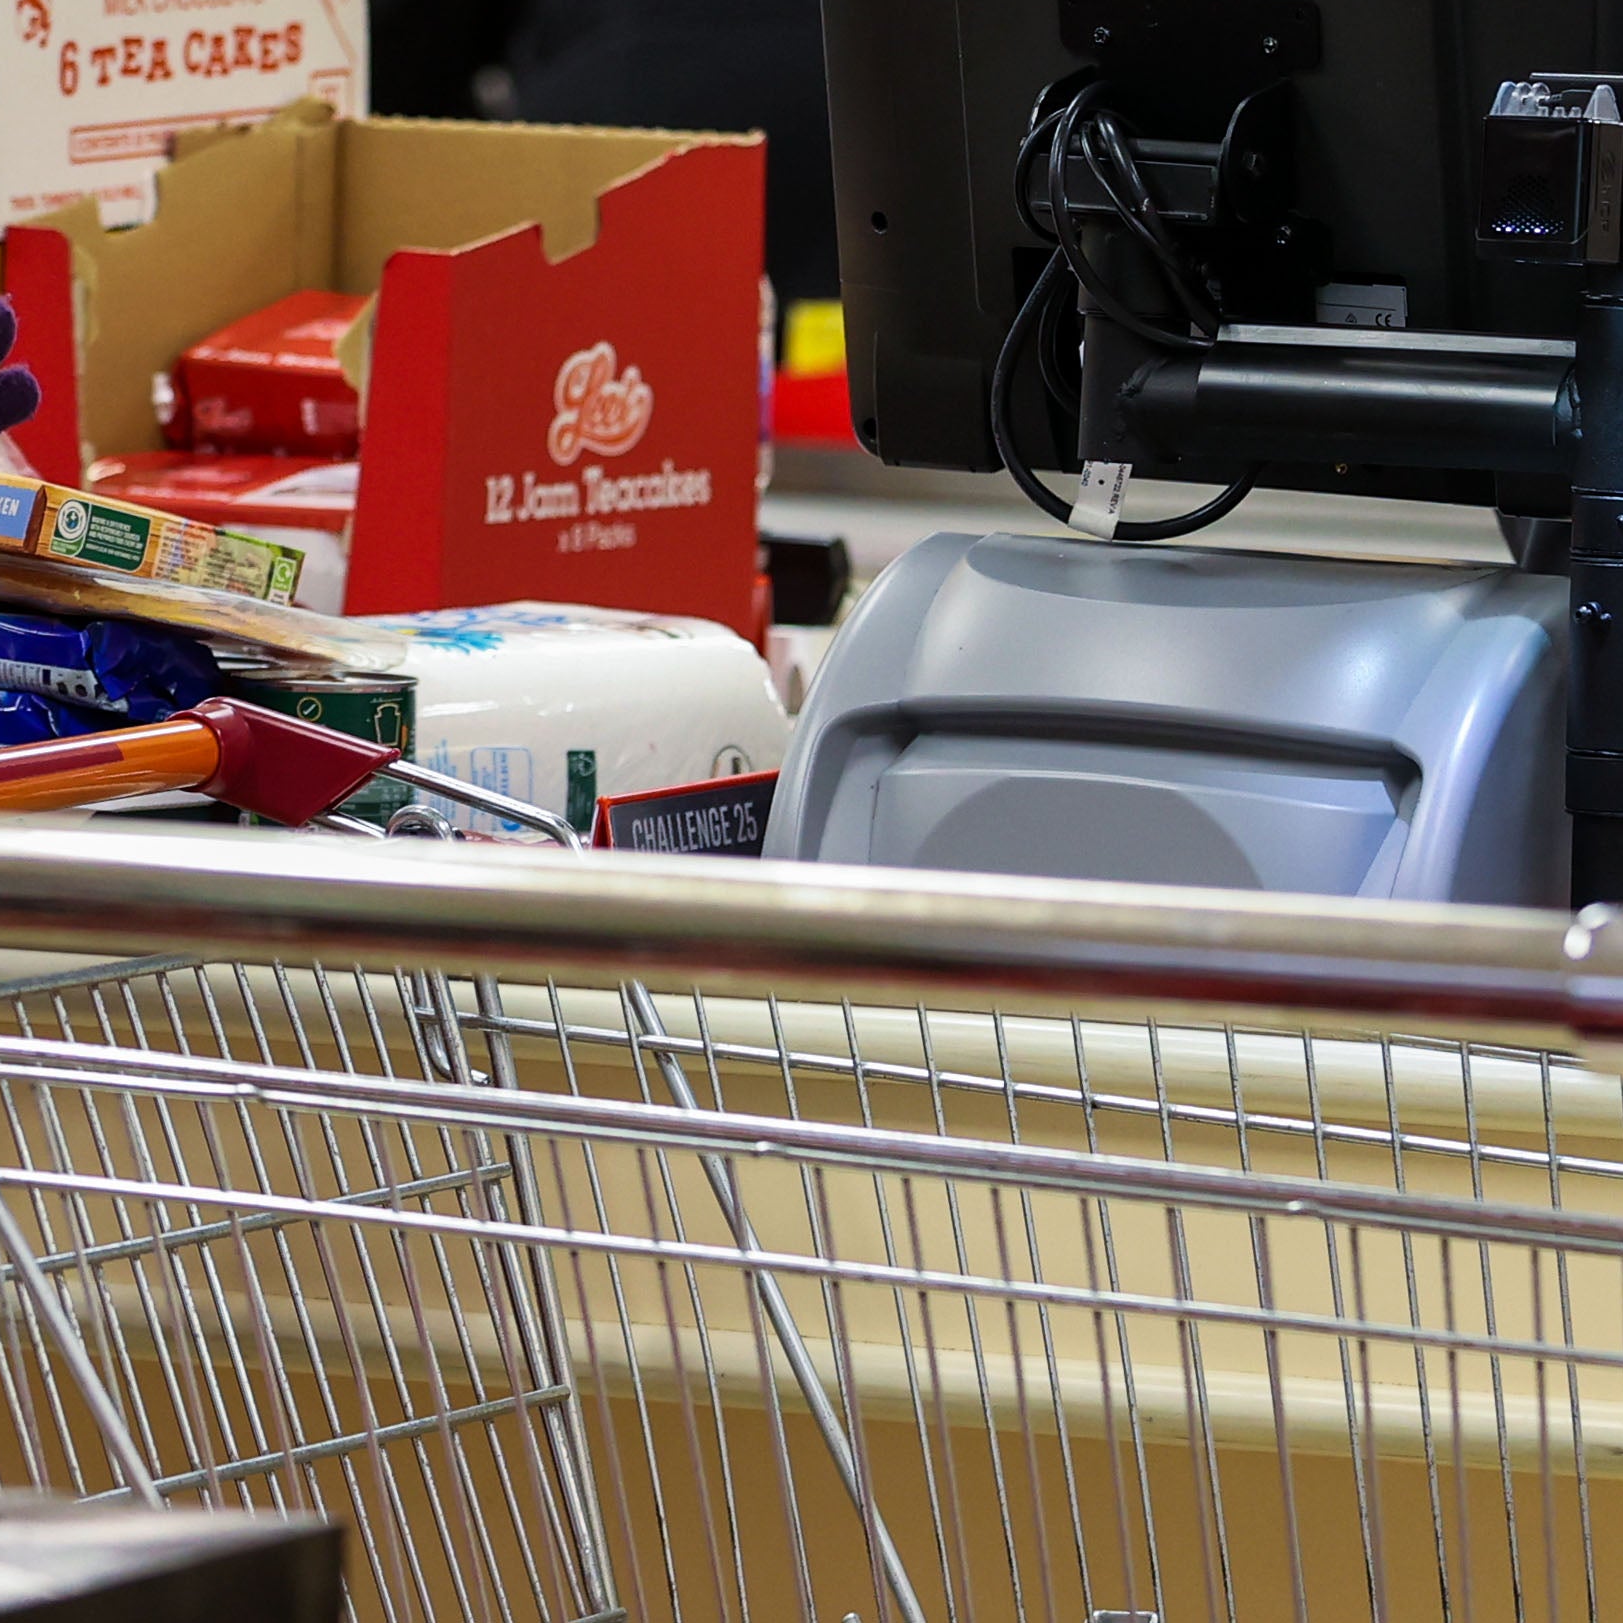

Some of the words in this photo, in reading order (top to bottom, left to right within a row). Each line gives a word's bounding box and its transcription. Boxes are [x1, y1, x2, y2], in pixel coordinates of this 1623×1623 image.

[57, 39, 80, 98] 6
[89, 36, 174, 88] TEA
[182, 21, 305, 78] CAKES
[484, 474, 515, 524] 12
[517, 471, 581, 522] Jam
[582, 458, 712, 515] Teacakes
[632, 807, 731, 854] CHALLENGE
[733, 802, 758, 843] 25
